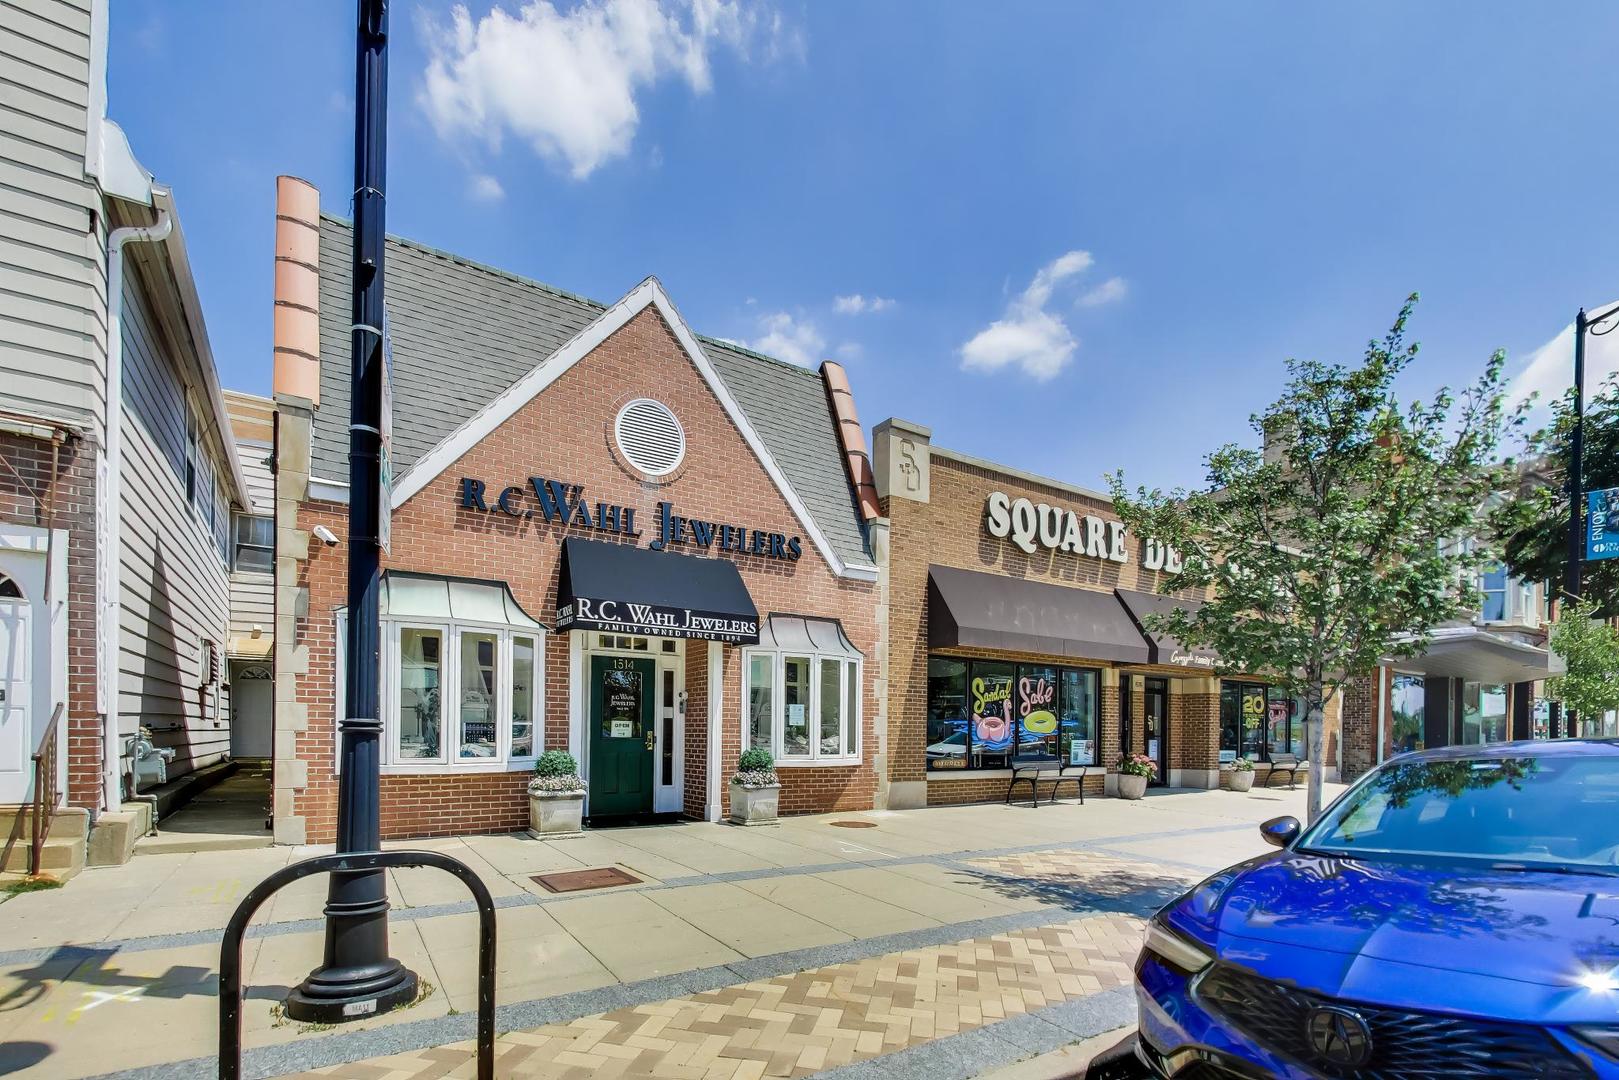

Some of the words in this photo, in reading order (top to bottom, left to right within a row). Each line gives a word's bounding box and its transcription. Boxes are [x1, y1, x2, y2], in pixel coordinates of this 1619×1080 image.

[528, 477, 642, 536] WAHL
[650, 501, 803, 561] JEWELERS
[986, 491, 1129, 564] SQUARE
[1143, 537, 1191, 576] DE
[576, 597, 621, 621] R.C.
[626, 602, 679, 627] WAHL
[682, 609, 757, 634] JEWELERS
[598, 623, 638, 633] FAMILY
[643, 627, 682, 637] OWNED
[686, 631, 716, 640] SINCE
[613, 658, 634, 670] 1514
[1242, 695, 1265, 714] 20
